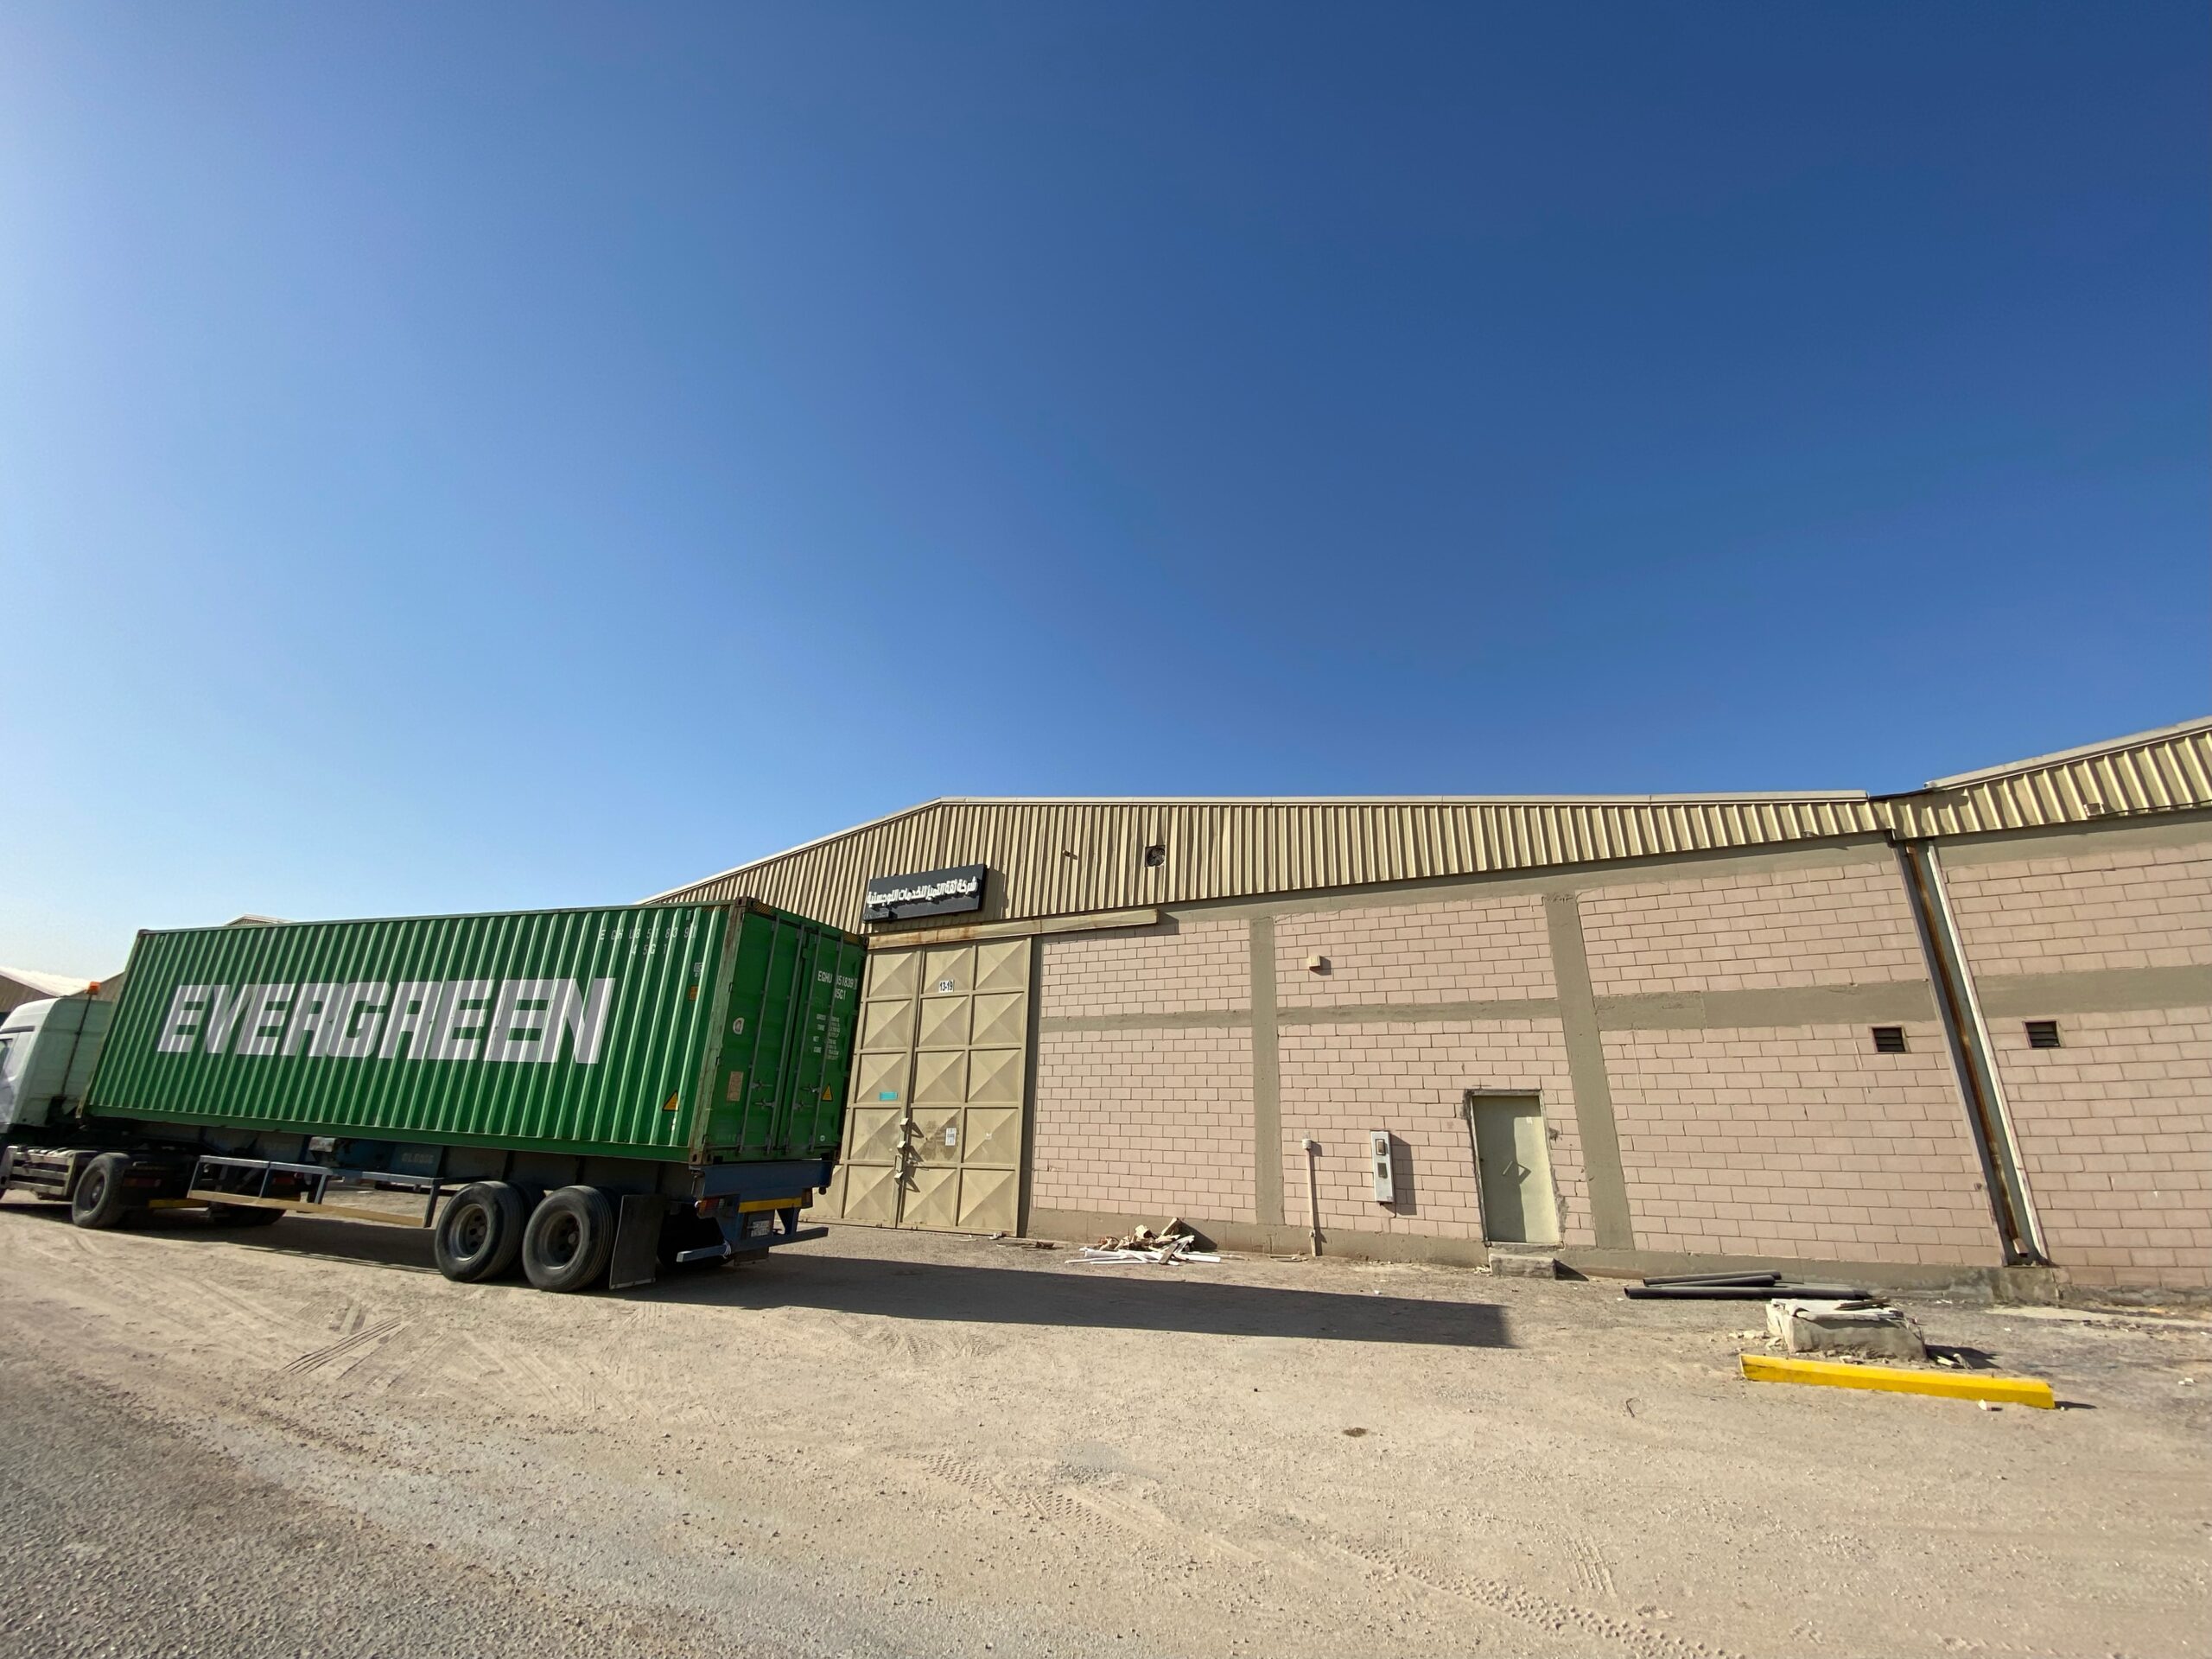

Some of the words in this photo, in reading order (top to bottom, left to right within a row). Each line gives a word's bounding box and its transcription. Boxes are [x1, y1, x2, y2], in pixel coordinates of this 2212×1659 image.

[899, 885, 928, 901] للخدمات
[957, 876, 977, 895] شركة
[817, 970, 833, 983] EGHU
[156, 977, 615, 1064] EVERGREEN
